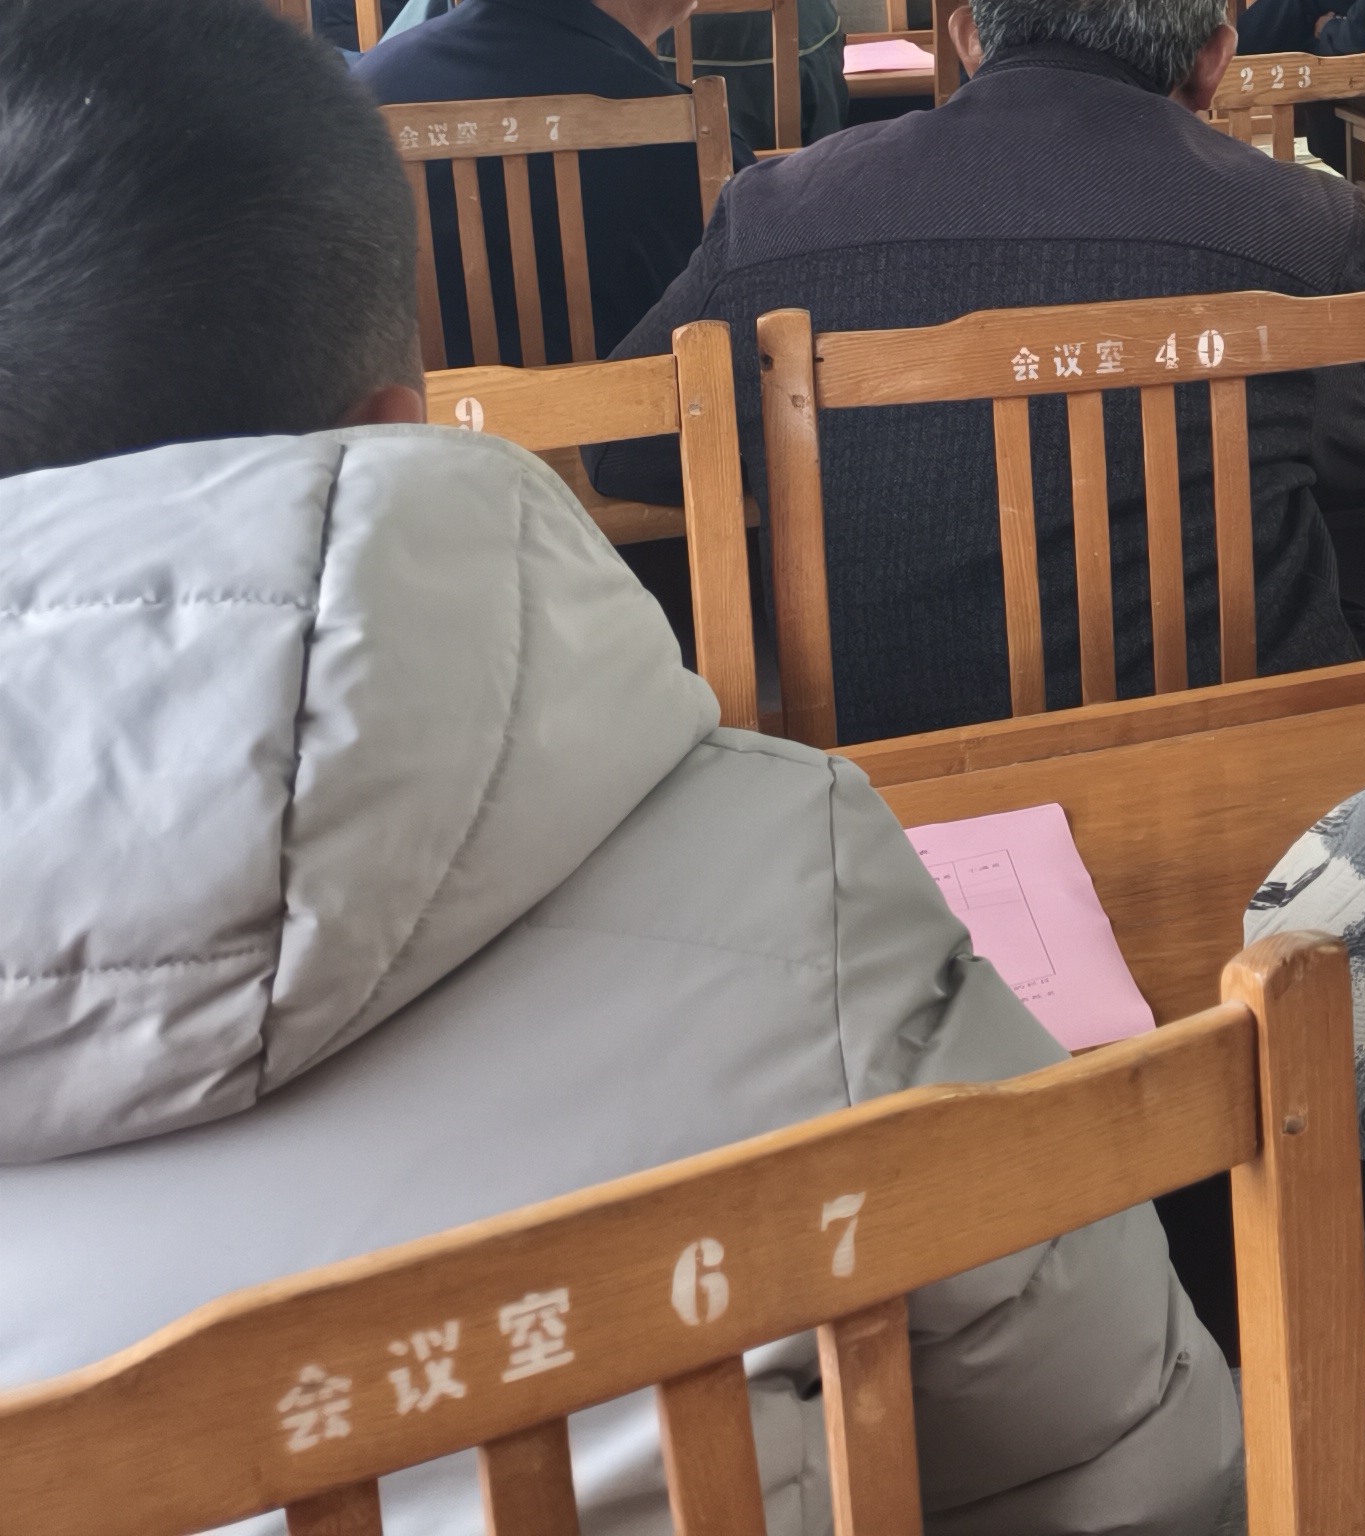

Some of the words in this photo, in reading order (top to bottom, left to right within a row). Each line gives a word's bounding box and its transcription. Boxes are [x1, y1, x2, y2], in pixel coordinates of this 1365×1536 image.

[1240, 65, 1311, 92] 223
[400, 121, 478, 149] 会议室
[502, 115, 561, 143] 27
[1011, 340, 1124, 381] 会议室
[275, 1287, 575, 1453] 会议室
[671, 1191, 867, 1326] 67
